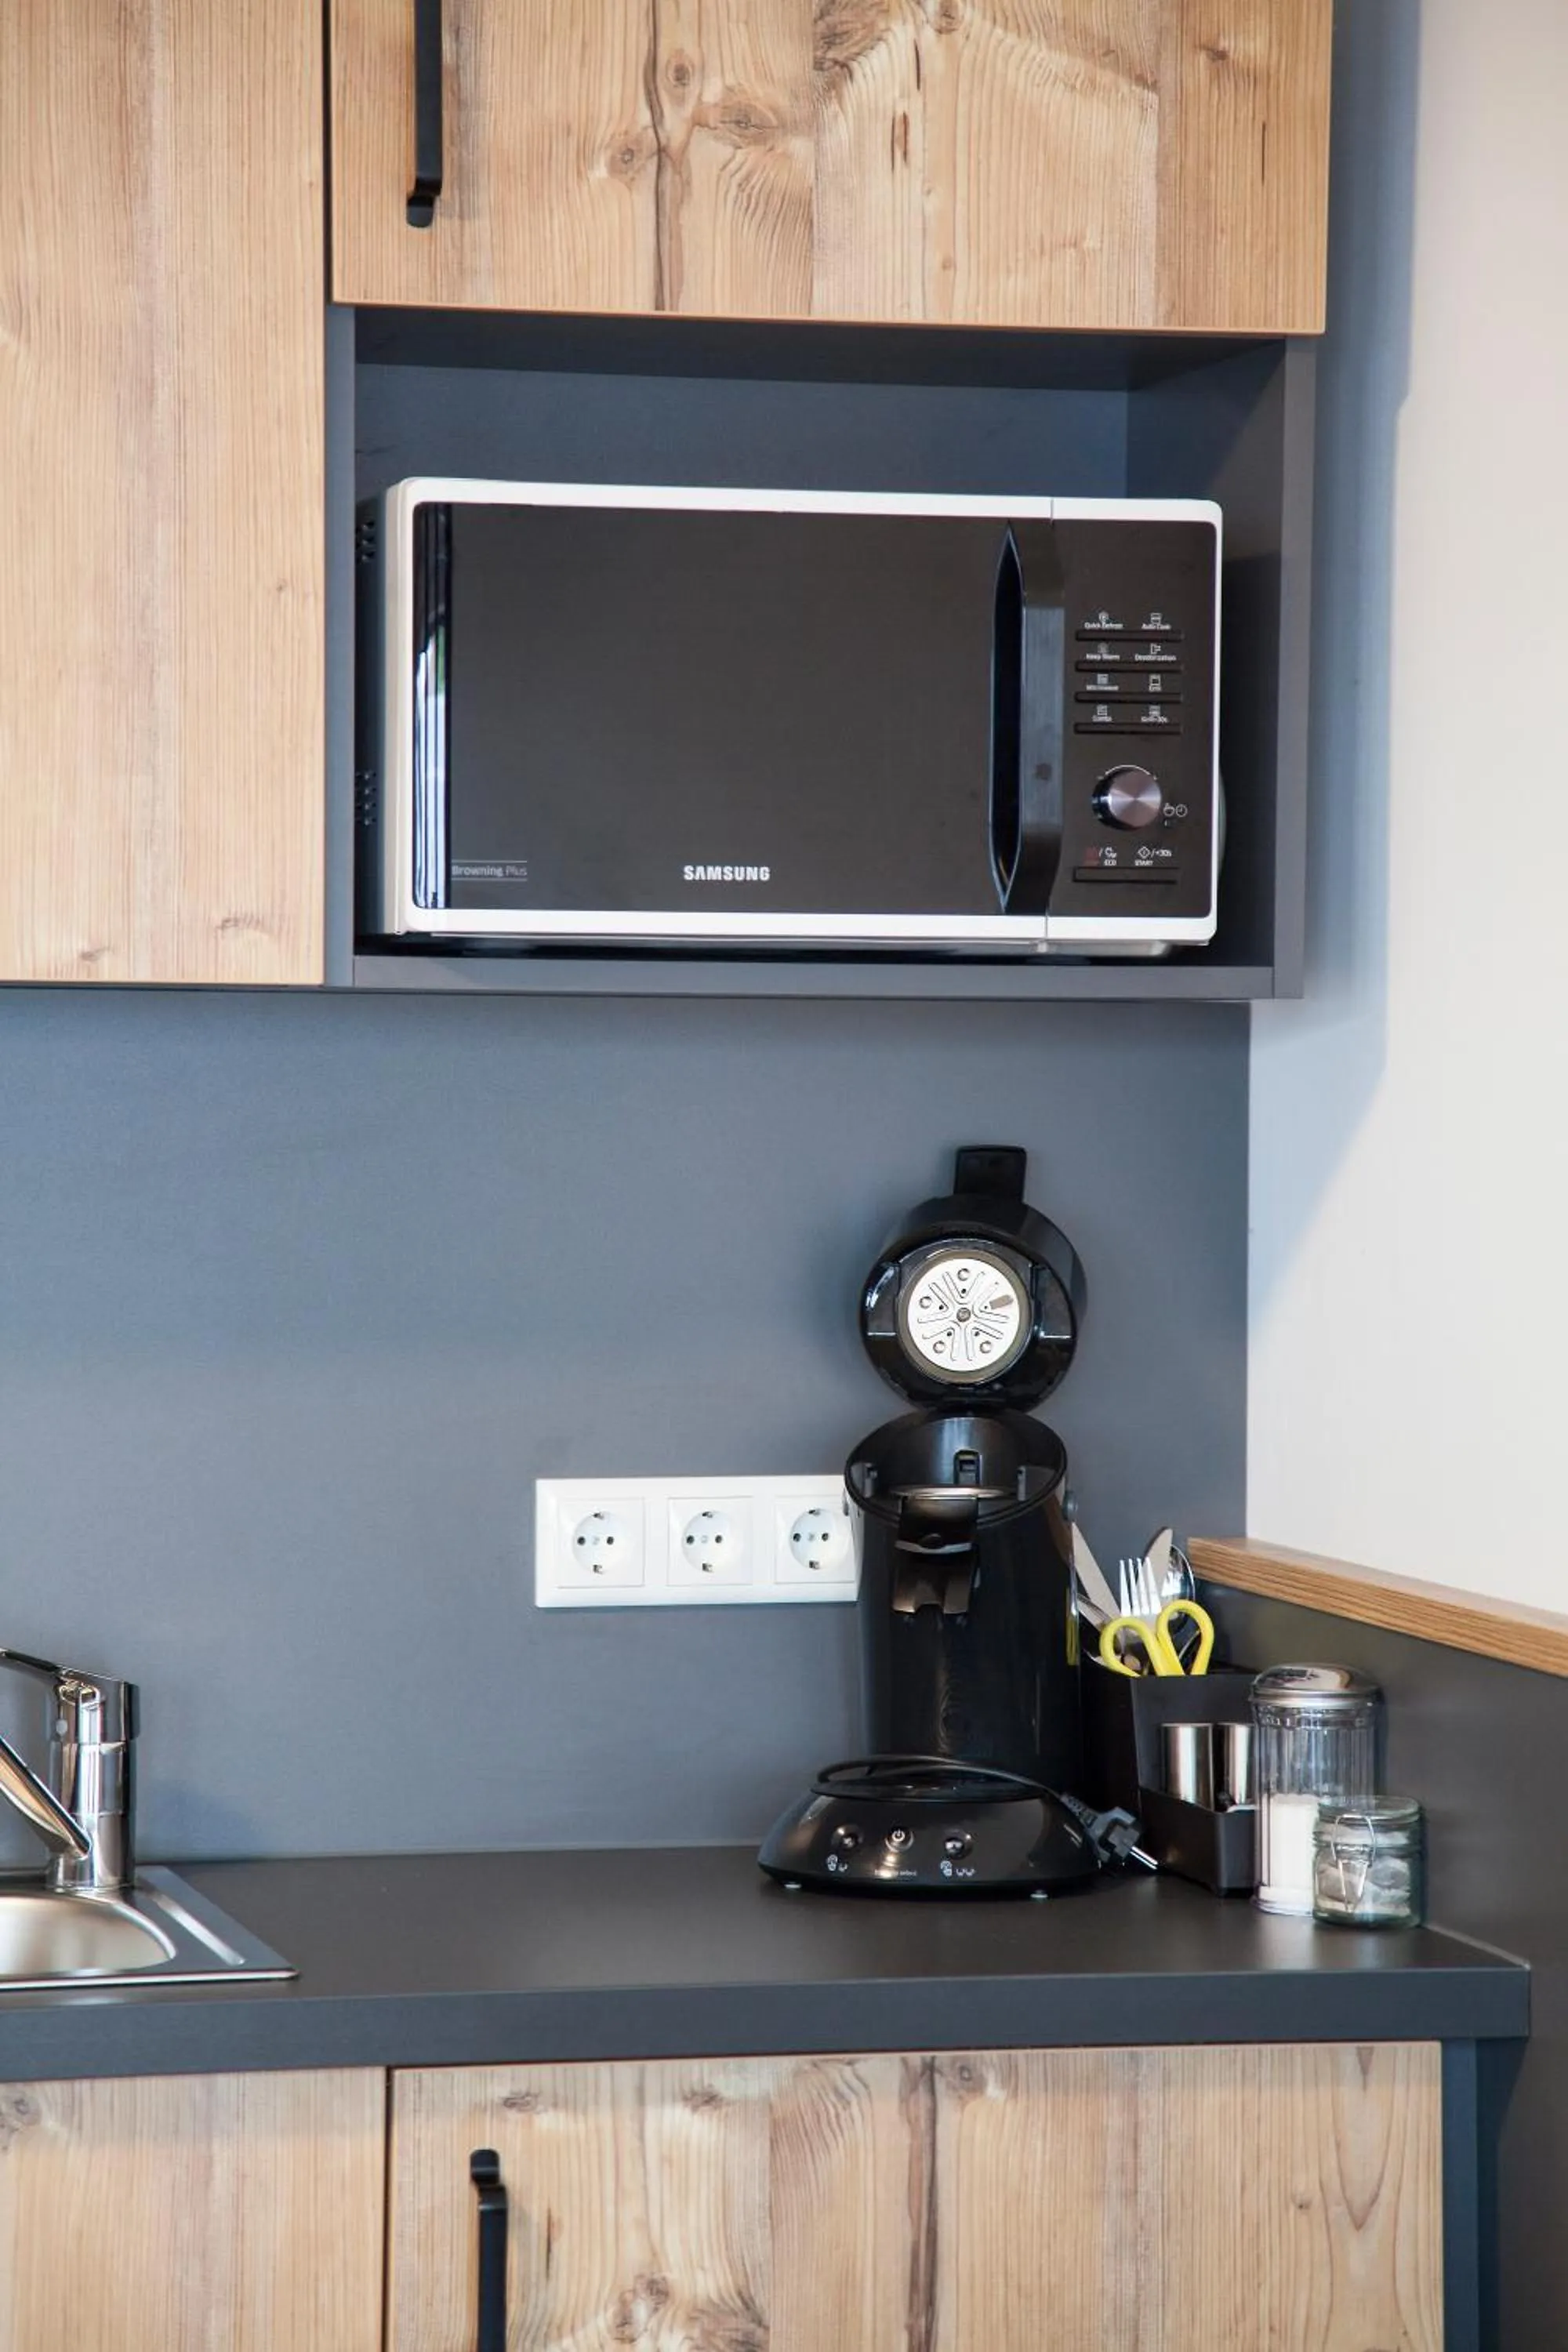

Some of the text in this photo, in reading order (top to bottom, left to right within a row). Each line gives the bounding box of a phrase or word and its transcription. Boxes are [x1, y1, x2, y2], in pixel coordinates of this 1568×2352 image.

[452, 866, 528, 877] Browning Plus
[684, 865, 770, 881] SAMSUNG
